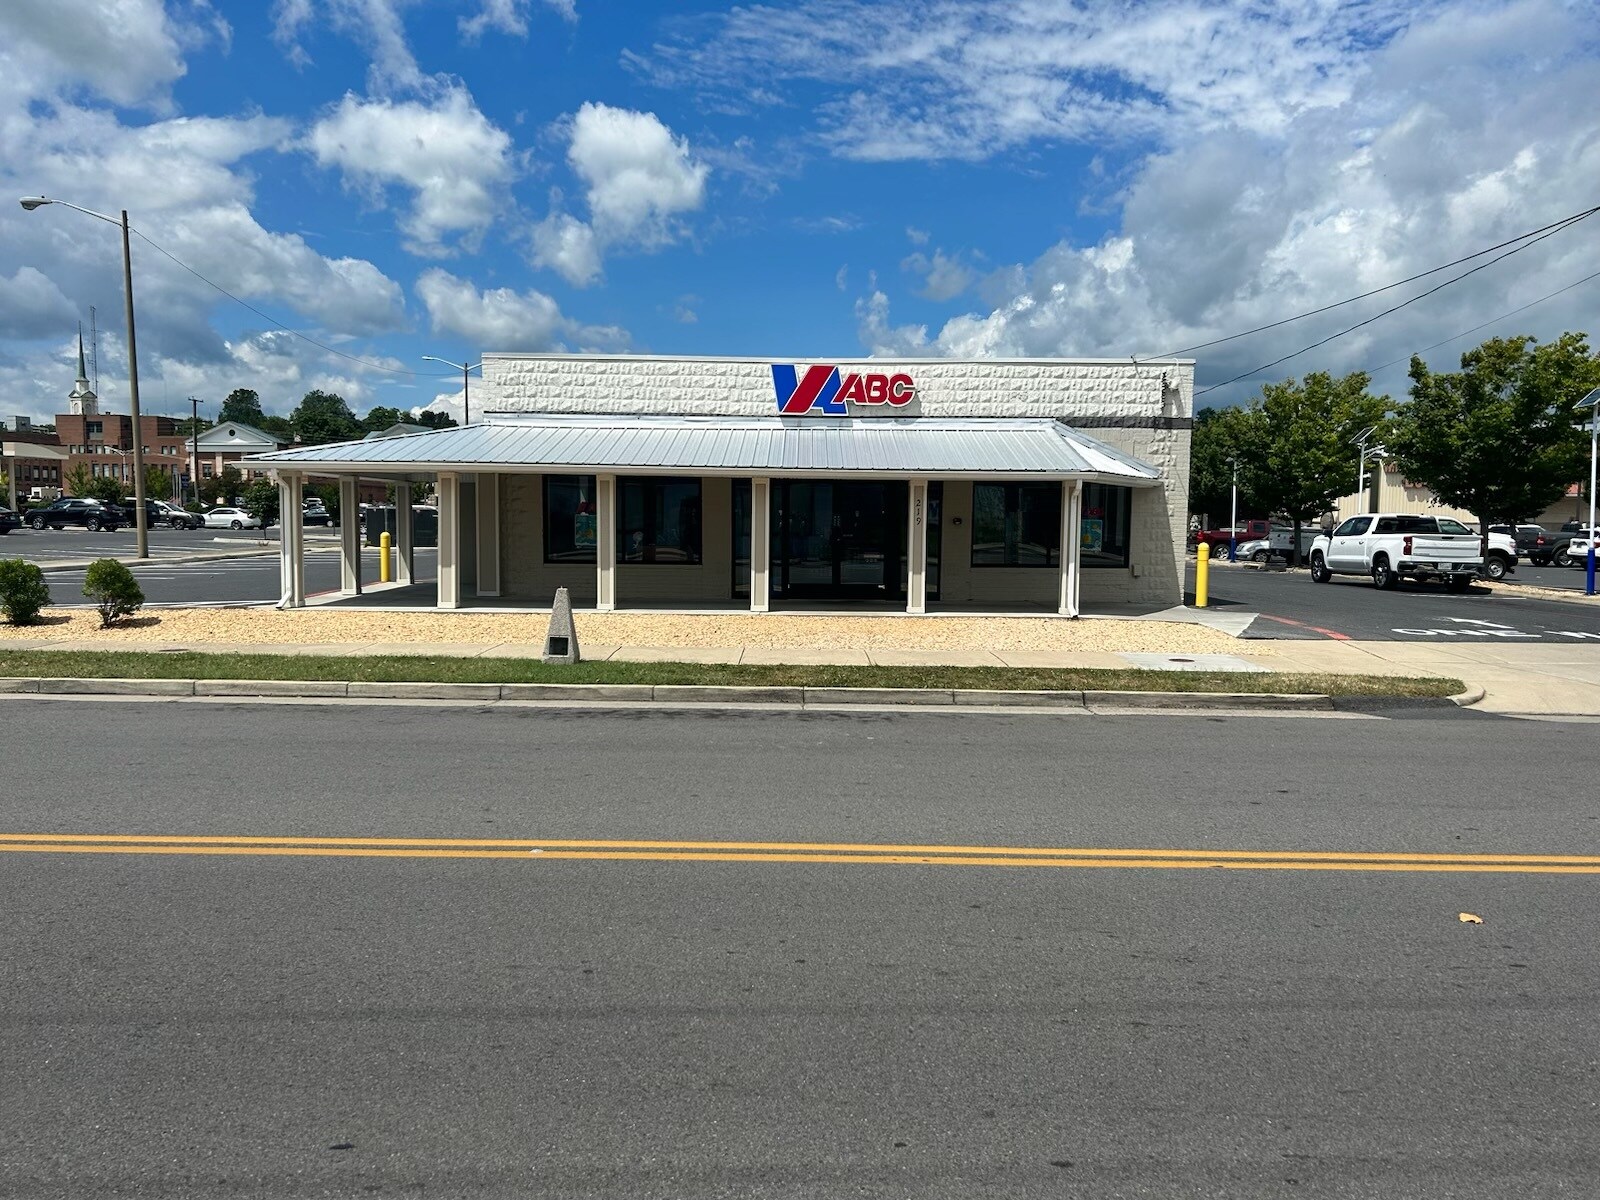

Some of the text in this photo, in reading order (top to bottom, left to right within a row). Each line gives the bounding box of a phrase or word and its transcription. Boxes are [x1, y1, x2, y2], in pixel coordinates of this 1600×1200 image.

[771, 364, 917, 415] VA ABC
[1391, 628, 1542, 637] ONE
